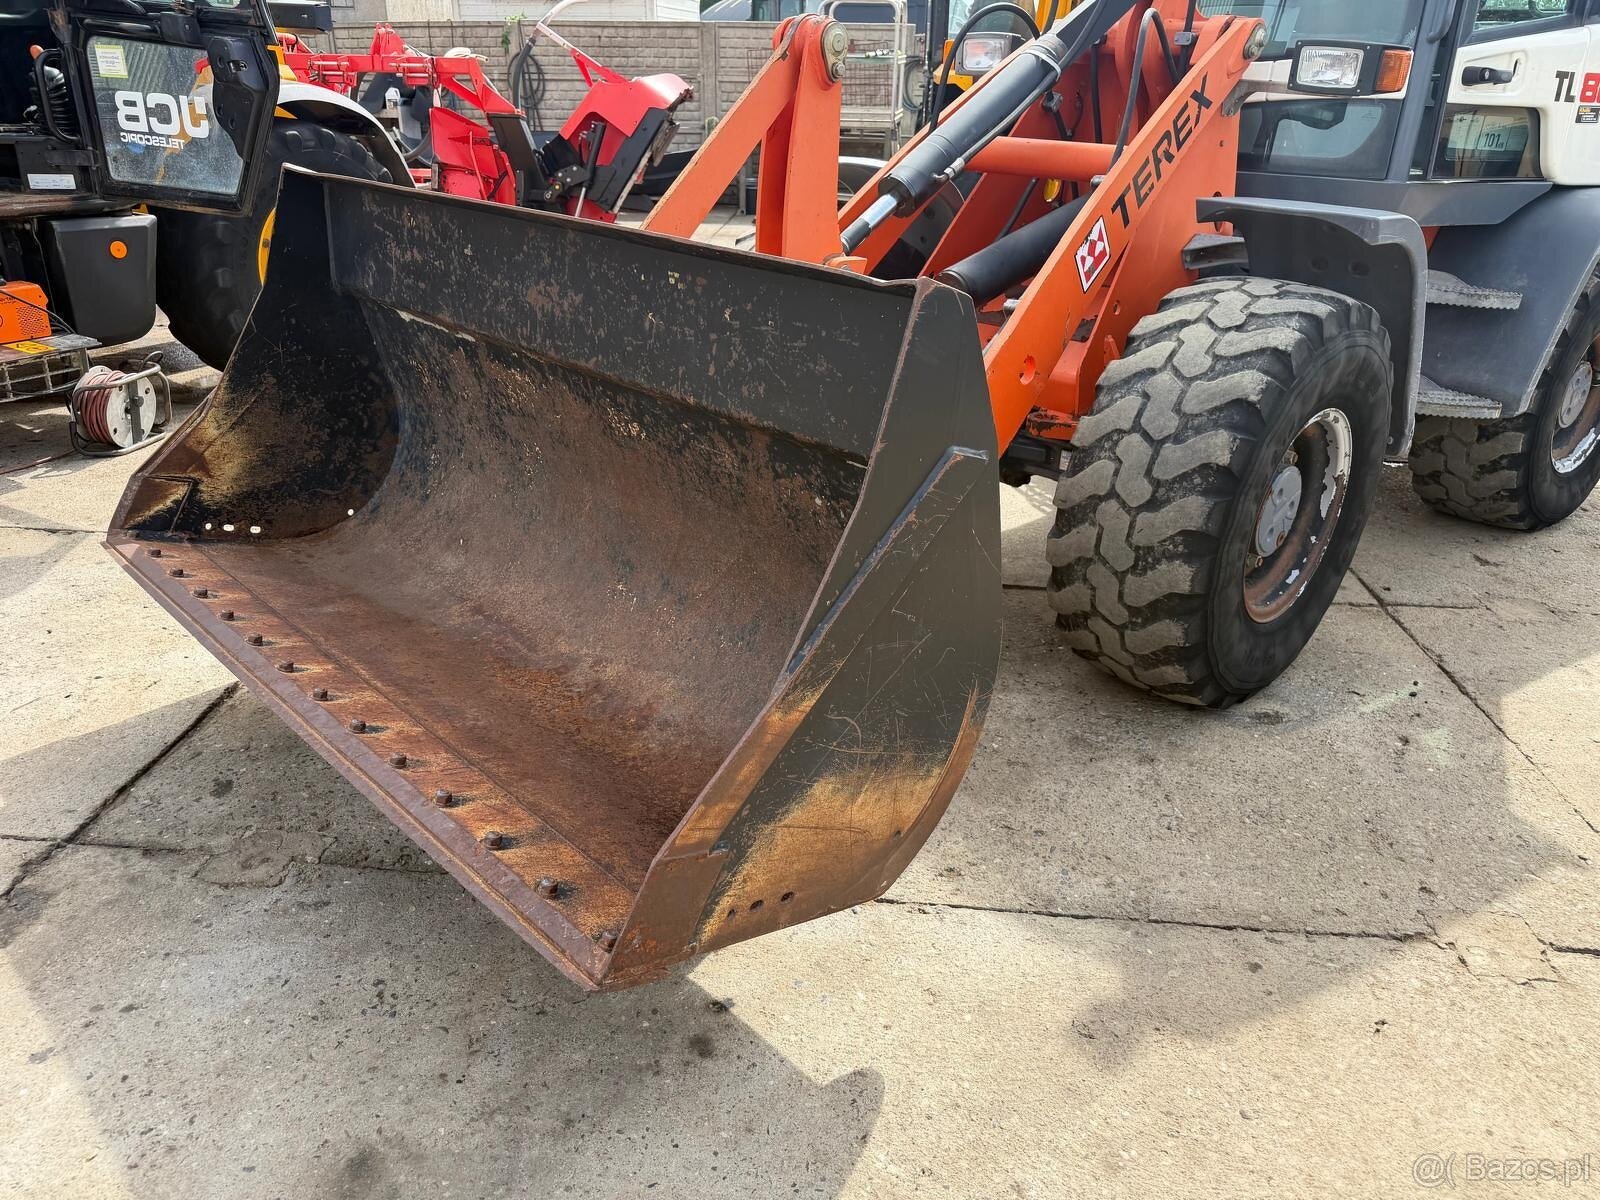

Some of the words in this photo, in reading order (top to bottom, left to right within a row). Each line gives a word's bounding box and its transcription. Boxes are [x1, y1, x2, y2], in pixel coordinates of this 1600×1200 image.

[1554, 70, 1600, 104] TL8
[1111, 72, 1213, 229] TEREX
[1484, 132, 1501, 148] 101
